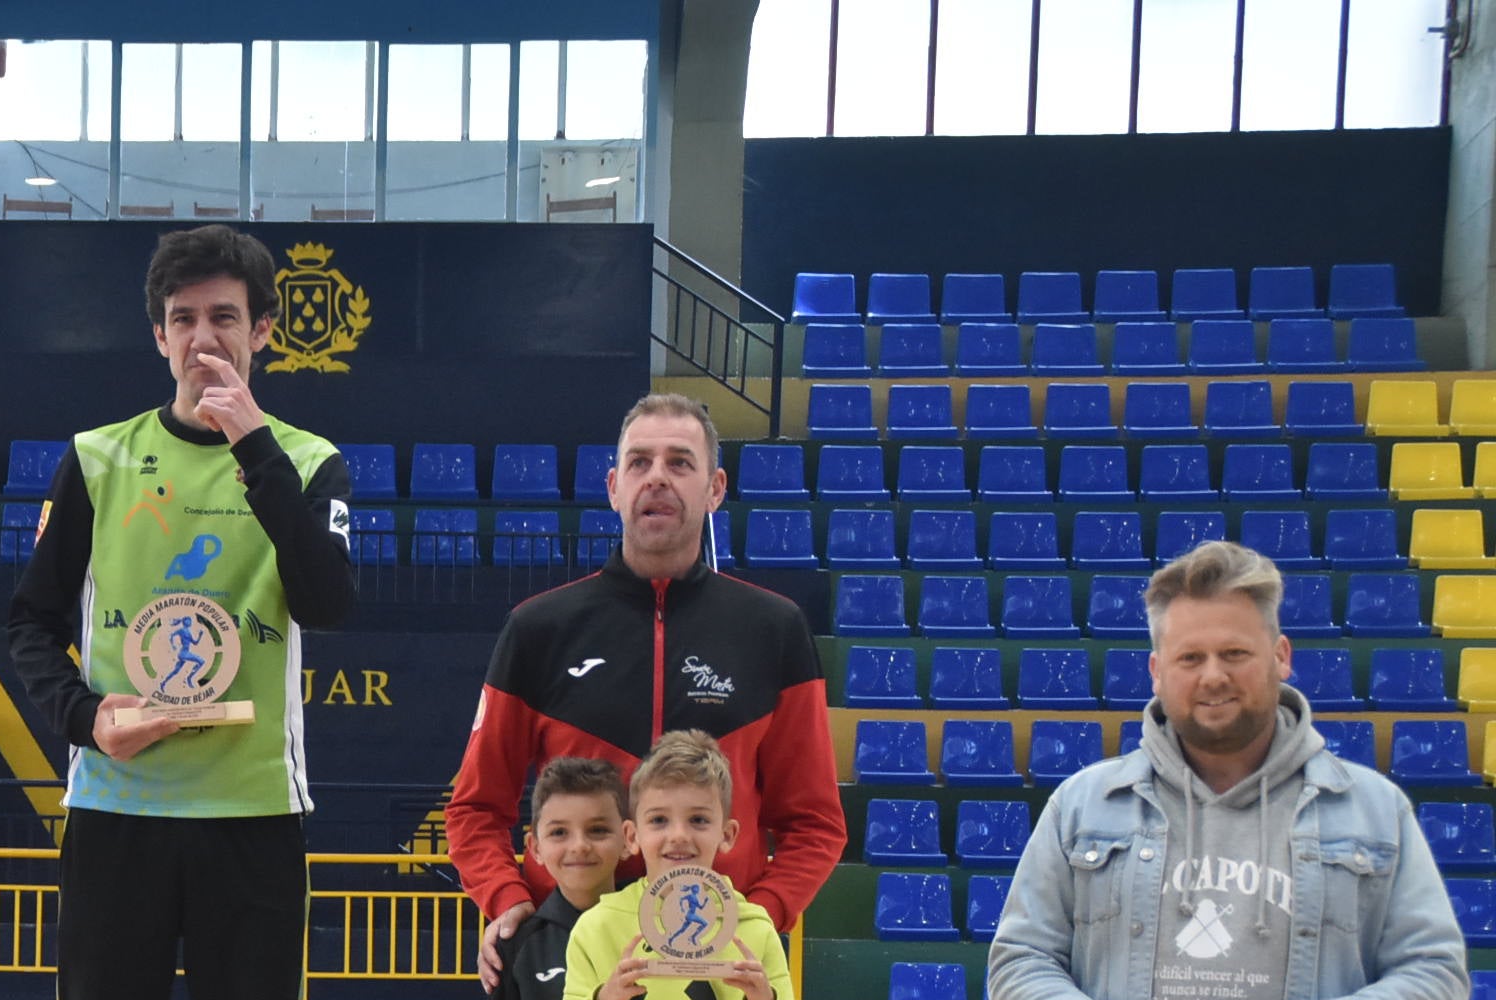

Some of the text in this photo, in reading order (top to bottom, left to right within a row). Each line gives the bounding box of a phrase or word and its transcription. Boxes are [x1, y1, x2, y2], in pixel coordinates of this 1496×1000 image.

[133, 610, 156, 635] MEDIA
[155, 597, 198, 613] MARATÓN
[197, 602, 230, 633] POPULAR
[152, 687, 215, 705] CIUDAD DE BÉJAR
[649, 868, 731, 901] MEDIA MARATÓN POPULAR
[660, 945, 685, 959] CIUDAD
[685, 951, 694, 960] DE
[1194, 970, 1233, 982] vencer
[1234, 969, 1245, 983] al
[1247, 973, 1270, 988] que
[1162, 984, 1248, 999] nunca se rinde.
